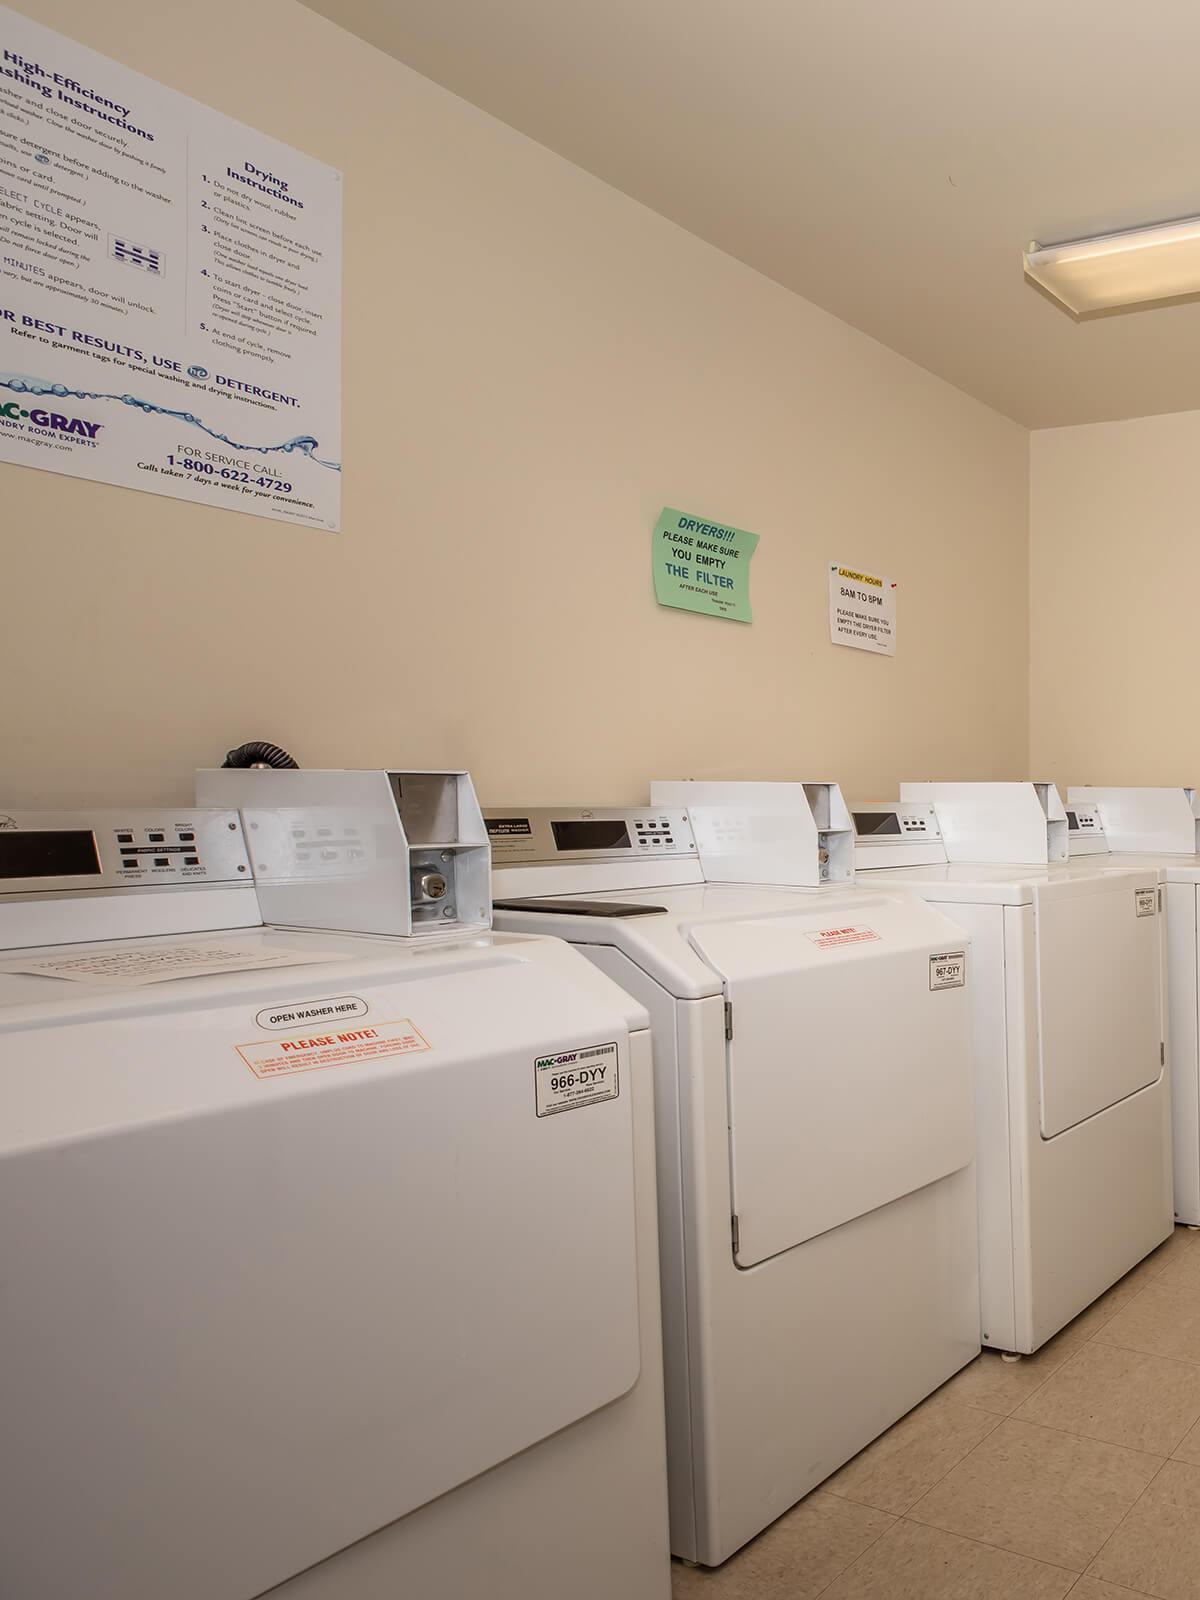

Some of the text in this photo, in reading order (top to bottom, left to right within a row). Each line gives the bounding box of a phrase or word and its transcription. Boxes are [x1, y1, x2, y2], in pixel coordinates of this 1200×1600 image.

[4, 50, 130, 117] High-Efficiency
[26, 99, 43, 109] and
[46, 107, 68, 120] close
[71, 118, 92, 130] door
[58, 90, 154, 141] Instructions
[20, 138, 61, 158] detergent
[63, 153, 90, 170] before
[91, 167, 119, 184] adding
[121, 179, 129, 187] to
[131, 183, 143, 192] the
[244, 161, 289, 192] Drying
[213, 180, 225, 190] Do
[226, 187, 240, 197] not
[241, 193, 252, 203] dry
[274, 207, 297, 221] rubber
[226, 167, 304, 209] Instructions
[10, 217, 32, 229] cycle
[34, 225, 41, 233] is
[33, 199, 63, 216] CYCLE
[65, 213, 101, 231] appears,
[60, 221, 82, 234] Door
[84, 231, 98, 240] will
[213, 206, 234, 220] Clean
[249, 222, 271, 235] screen
[272, 231, 293, 244] before
[294, 241, 310, 252] each
[3, 256, 46, 277] MINUTES
[47, 273, 86, 292] appears,
[88, 287, 108, 298] door
[111, 295, 125, 304] will
[211, 328, 220, 336] At
[222, 332, 236, 340] end
[267, 346, 291, 359] remove
[211, 338, 241, 354] clothing
[11, 327, 278, 411] Refer to garment tags for special washing and drying instructions.
[22, 315, 67, 336] BEST
[72, 330, 147, 364] RESULTS,
[152, 355, 182, 372] USE
[215, 375, 301, 408] DETERGENT.
[28, 426, 56, 438] ROOM
[167, 455, 292, 493] 1-800-622-4729
[177, 445, 282, 477] FOR SERVICE CALL:
[137, 462, 158, 472] Calls
[161, 468, 184, 478] taken
[194, 475, 211, 485] days
[221, 482, 240, 491] week
[241, 486, 253, 494] for
[272, 494, 315, 509] convenience.
[663, 531, 740, 559] PLEASE MAKE SURE
[678, 517, 735, 542] DRYERS!!!
[671, 547, 726, 569] YOU EMPTY
[665, 562, 734, 590] THE FILTER
[679, 583, 694, 592] AFTER
[838, 568, 882, 588] LAUNDRY HOURS
[840, 587, 882, 606] 8AM TO 8PM
[269, 1003, 358, 1024] OPEN WASHER HERE
[280, 1029, 379, 1052] PLEASE NOTE!
[551, 1066, 607, 1090] 966-DYY
